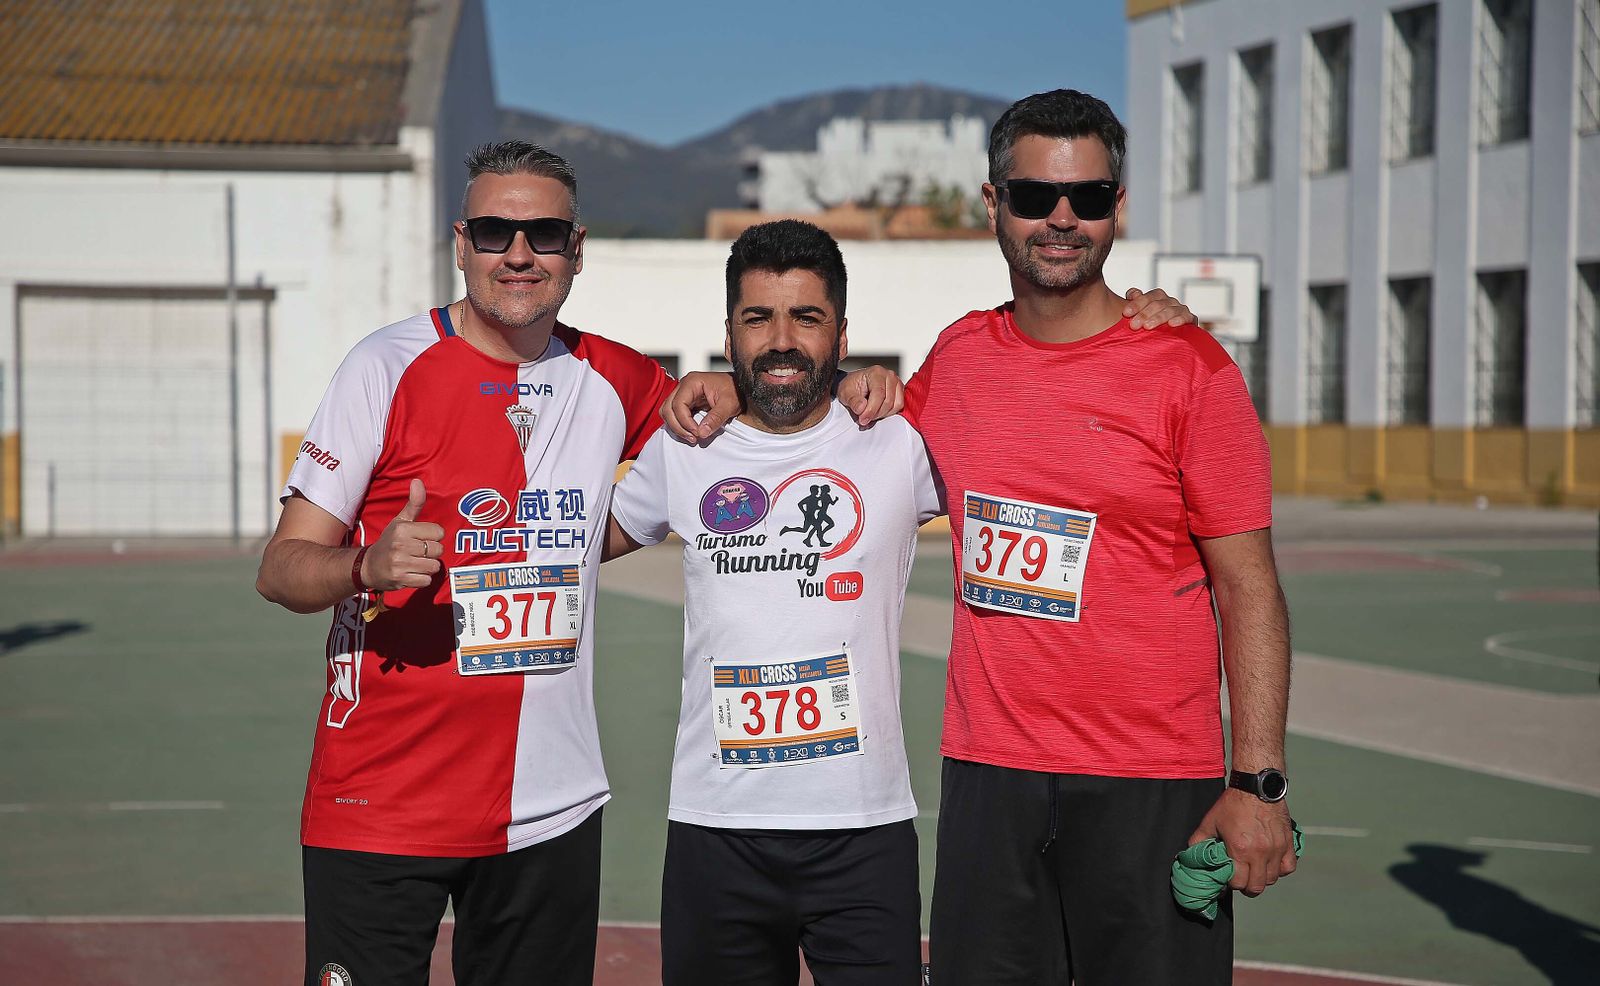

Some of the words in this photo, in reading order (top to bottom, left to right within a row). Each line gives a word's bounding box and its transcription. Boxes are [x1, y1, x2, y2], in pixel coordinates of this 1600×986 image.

[480, 382, 553, 397] GIVOVA
[517, 489, 587, 521] 威视
[998, 504, 1036, 527] CROSS
[457, 529, 586, 551] NUCTECH
[695, 533, 768, 550] Turismo
[711, 548, 821, 576] Running
[975, 526, 1048, 581] 379
[508, 567, 540, 586] CROSS
[1063, 573, 1069, 582] L
[486, 591, 557, 640] 377
[569, 621, 577, 630] XL
[760, 664, 797, 684] CROSS
[740, 686, 821, 736] 378
[840, 711, 847, 721] S
